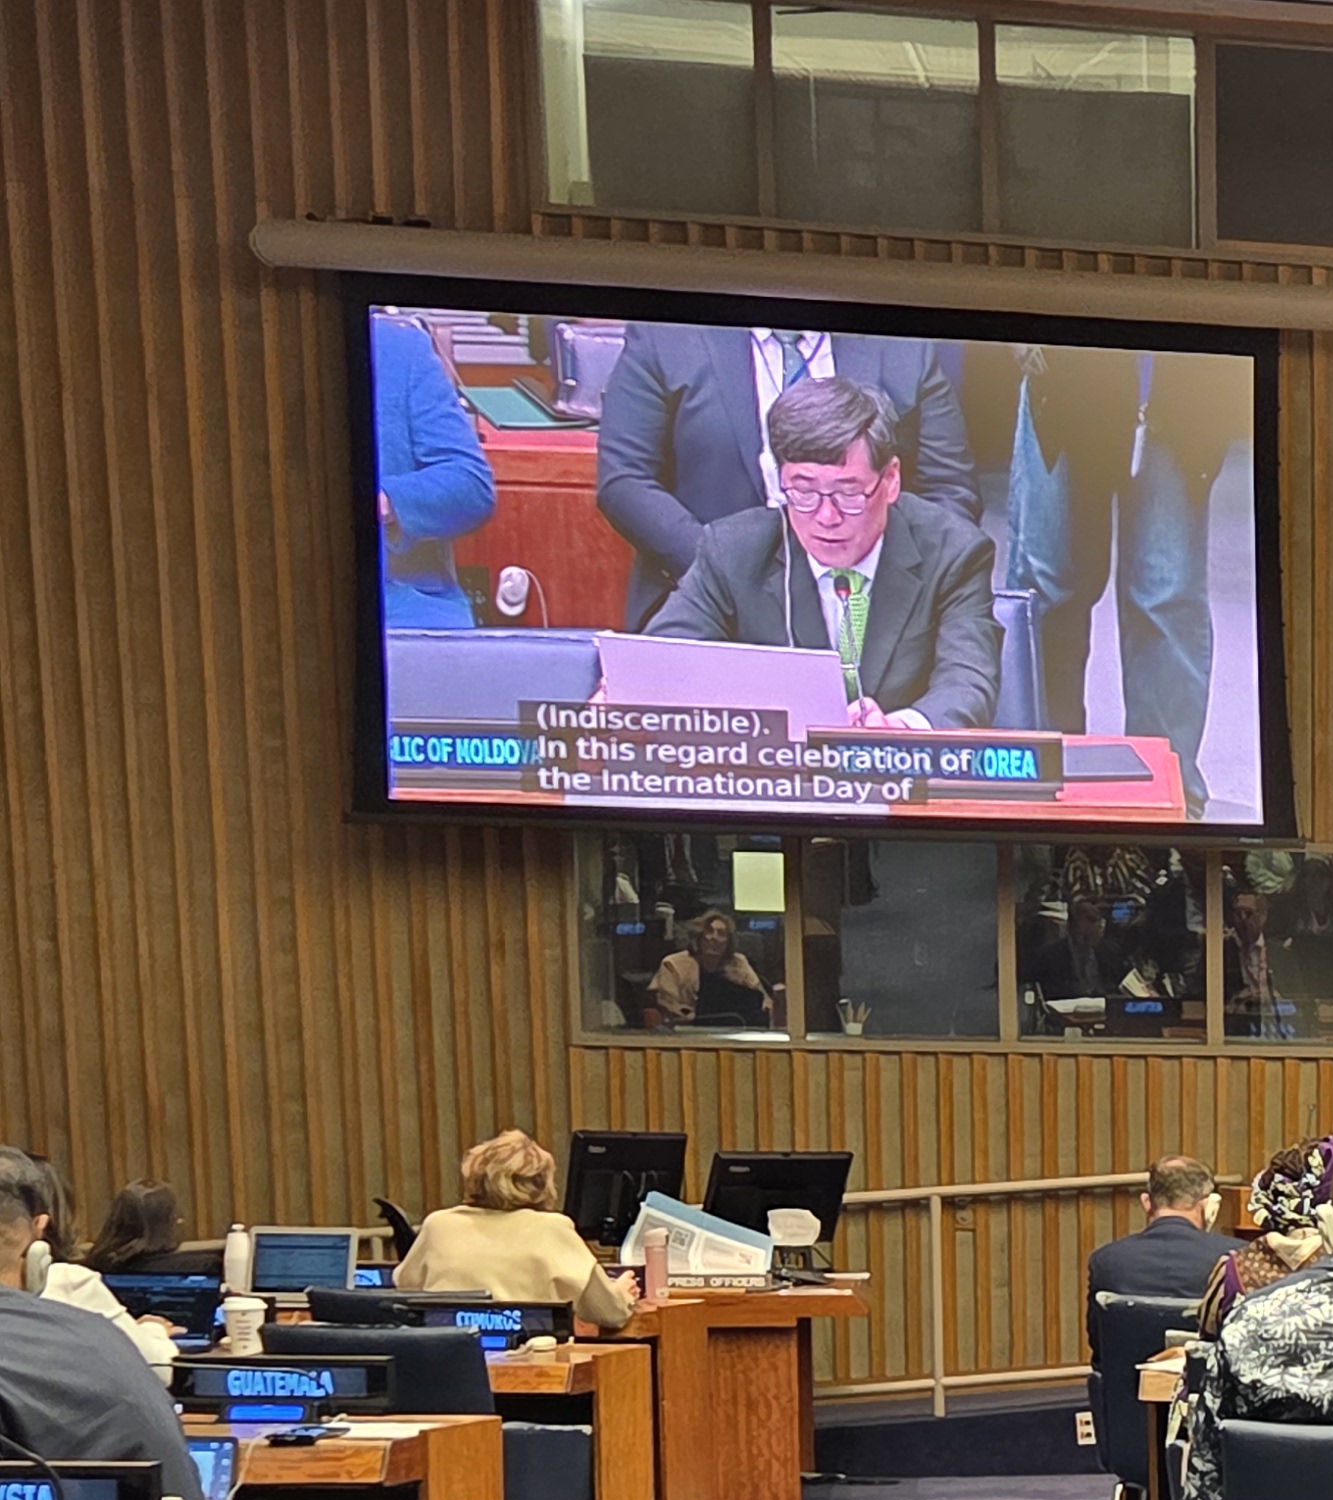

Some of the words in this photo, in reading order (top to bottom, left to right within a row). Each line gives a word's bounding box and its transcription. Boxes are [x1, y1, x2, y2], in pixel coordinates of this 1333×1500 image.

[537, 703, 770, 738] (Indiscernible).
[427, 737, 454, 763] OF
[538, 735, 568, 759] In
[576, 736, 635, 761] this
[645, 741, 747, 768] regard
[758, 743, 931, 771] celebration
[940, 748, 971, 773] of
[970, 748, 1038, 780] KOREA
[538, 767, 591, 792] the
[602, 768, 801, 797] International
[813, 775, 872, 805] Day
[882, 777, 913, 801] of
[227, 1370, 334, 1397] GUATEMALA
